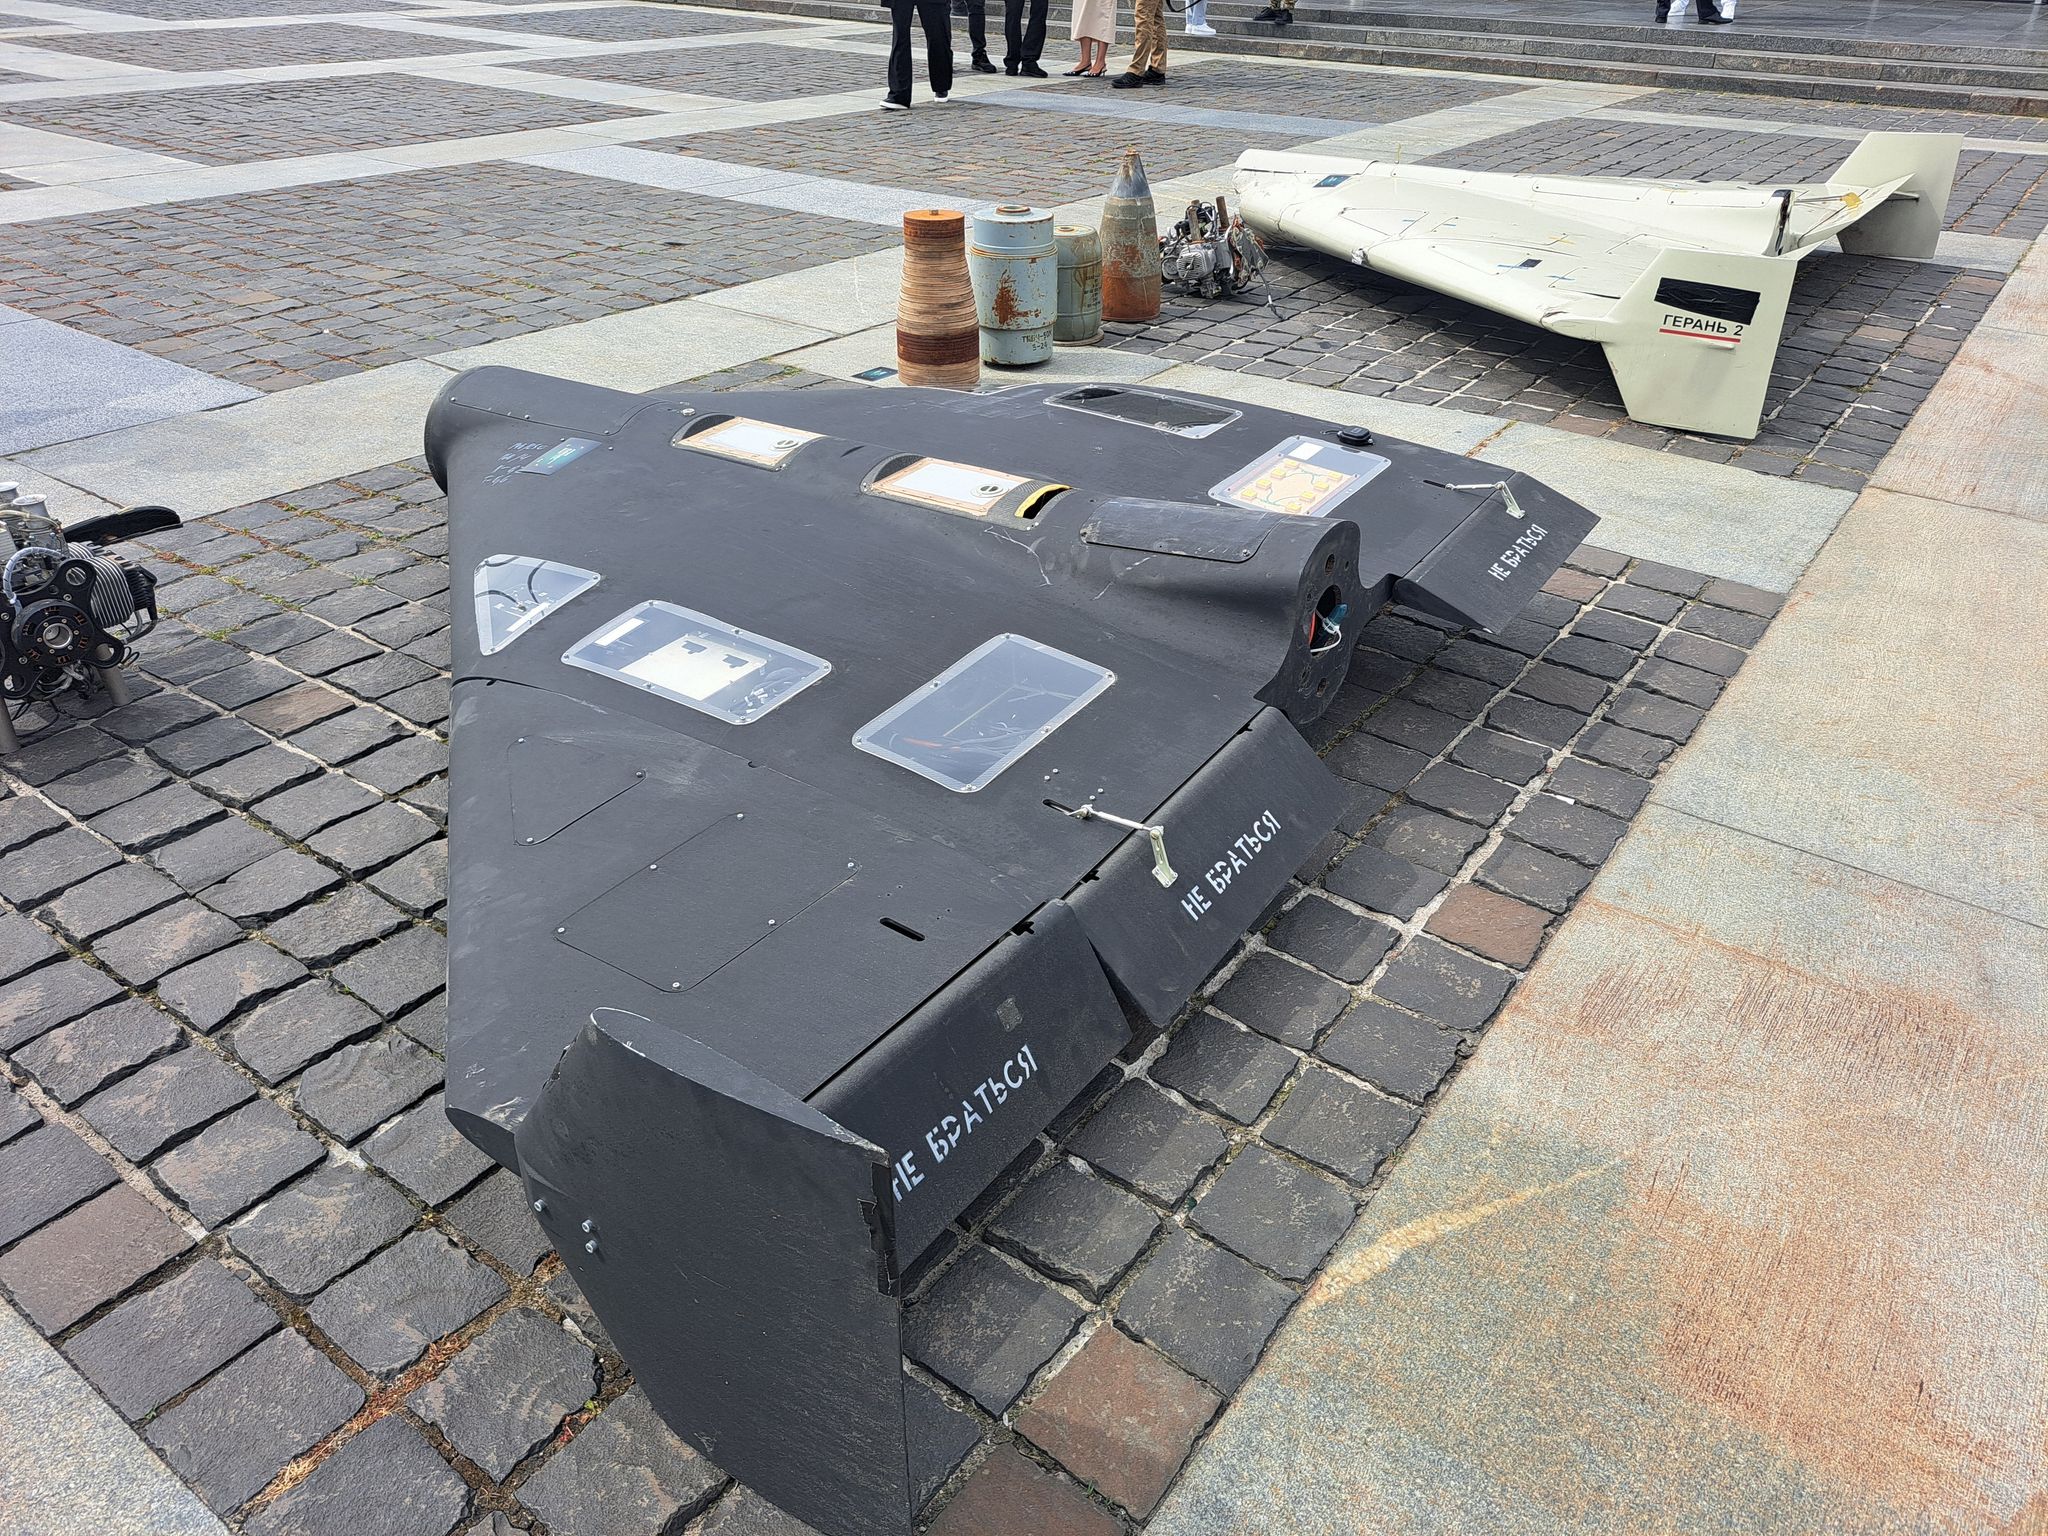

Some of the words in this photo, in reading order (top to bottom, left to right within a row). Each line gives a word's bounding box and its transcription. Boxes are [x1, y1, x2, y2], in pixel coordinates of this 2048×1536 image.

[1663, 314, 1728, 334] ГЕРАНЬ
[1733, 325, 1744, 336] 2
[1487, 562, 1512, 582] НЕ
[1500, 523, 1549, 568] БРАТЬСЯ
[1180, 884, 1213, 922] НЕ
[1204, 809, 1282, 895] БРАТЬСЯ
[925, 1043, 1039, 1164] БРАТЬСЯ
